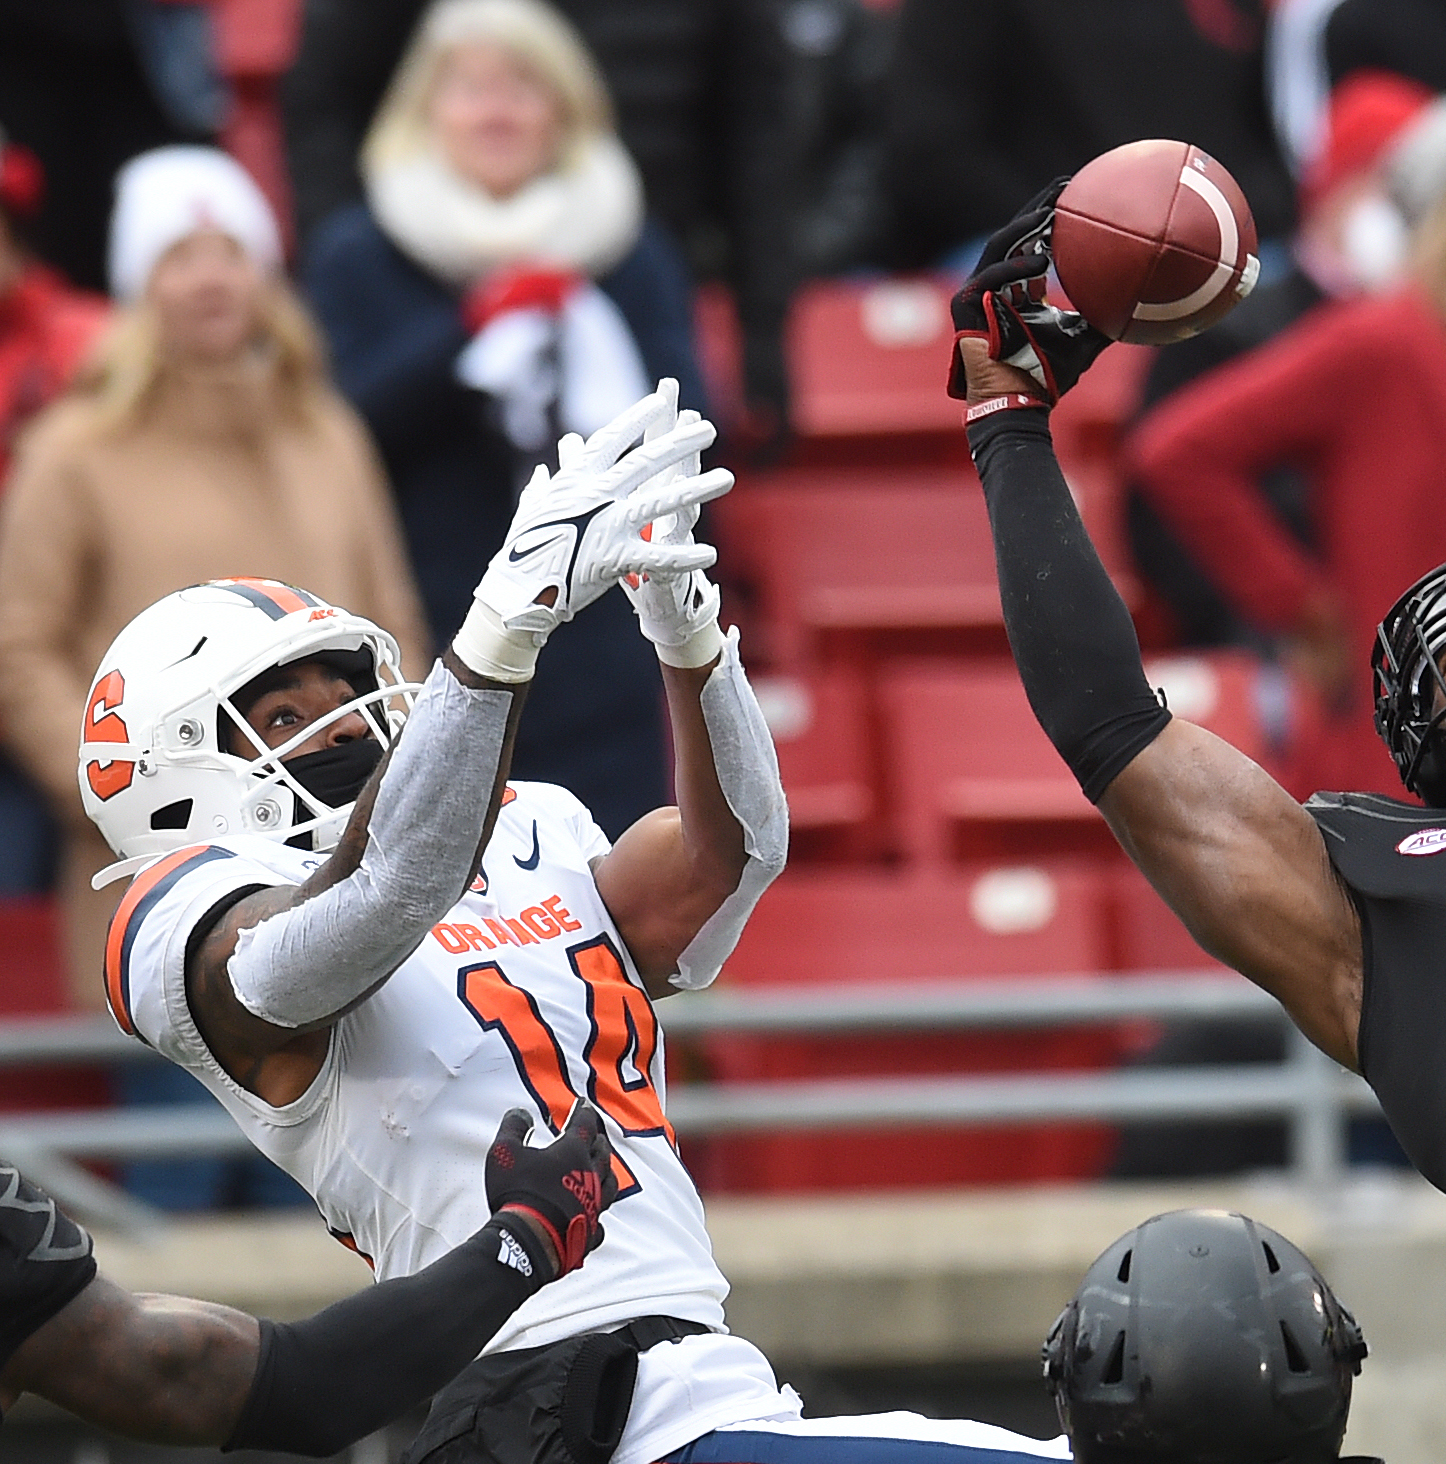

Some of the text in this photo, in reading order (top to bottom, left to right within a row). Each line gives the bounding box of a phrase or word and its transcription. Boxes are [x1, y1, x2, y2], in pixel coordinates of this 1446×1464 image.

[83, 668, 137, 803] S
[457, 930, 676, 1199] 14
[498, 1228, 534, 1278] adidas
